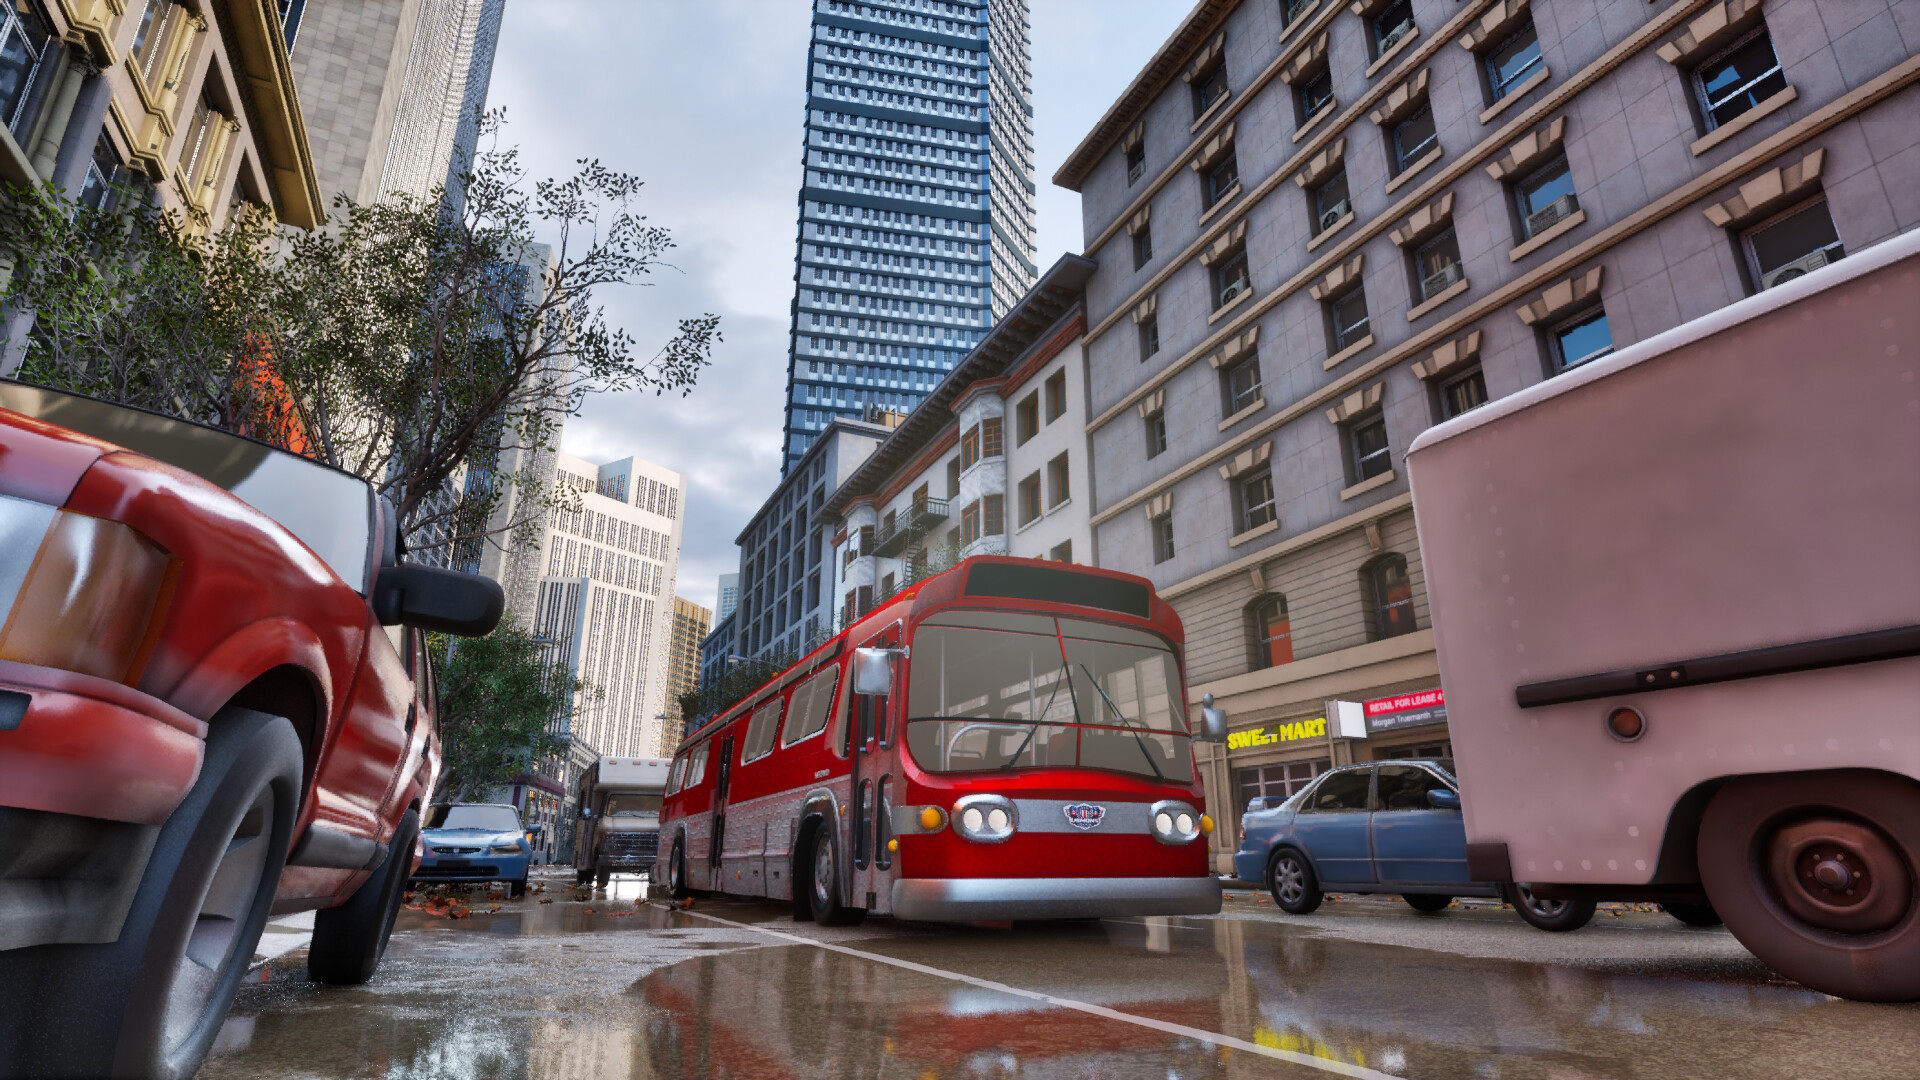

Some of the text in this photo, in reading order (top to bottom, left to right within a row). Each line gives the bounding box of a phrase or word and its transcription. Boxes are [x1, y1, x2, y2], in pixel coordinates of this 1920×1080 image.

[1369, 702, 1394, 713] RETAIL
[1395, 698, 1410, 708] FOR
[1412, 693, 1436, 705] LEASE
[1280, 718, 1326, 741] MART
[1372, 717, 1395, 727] Morgan
